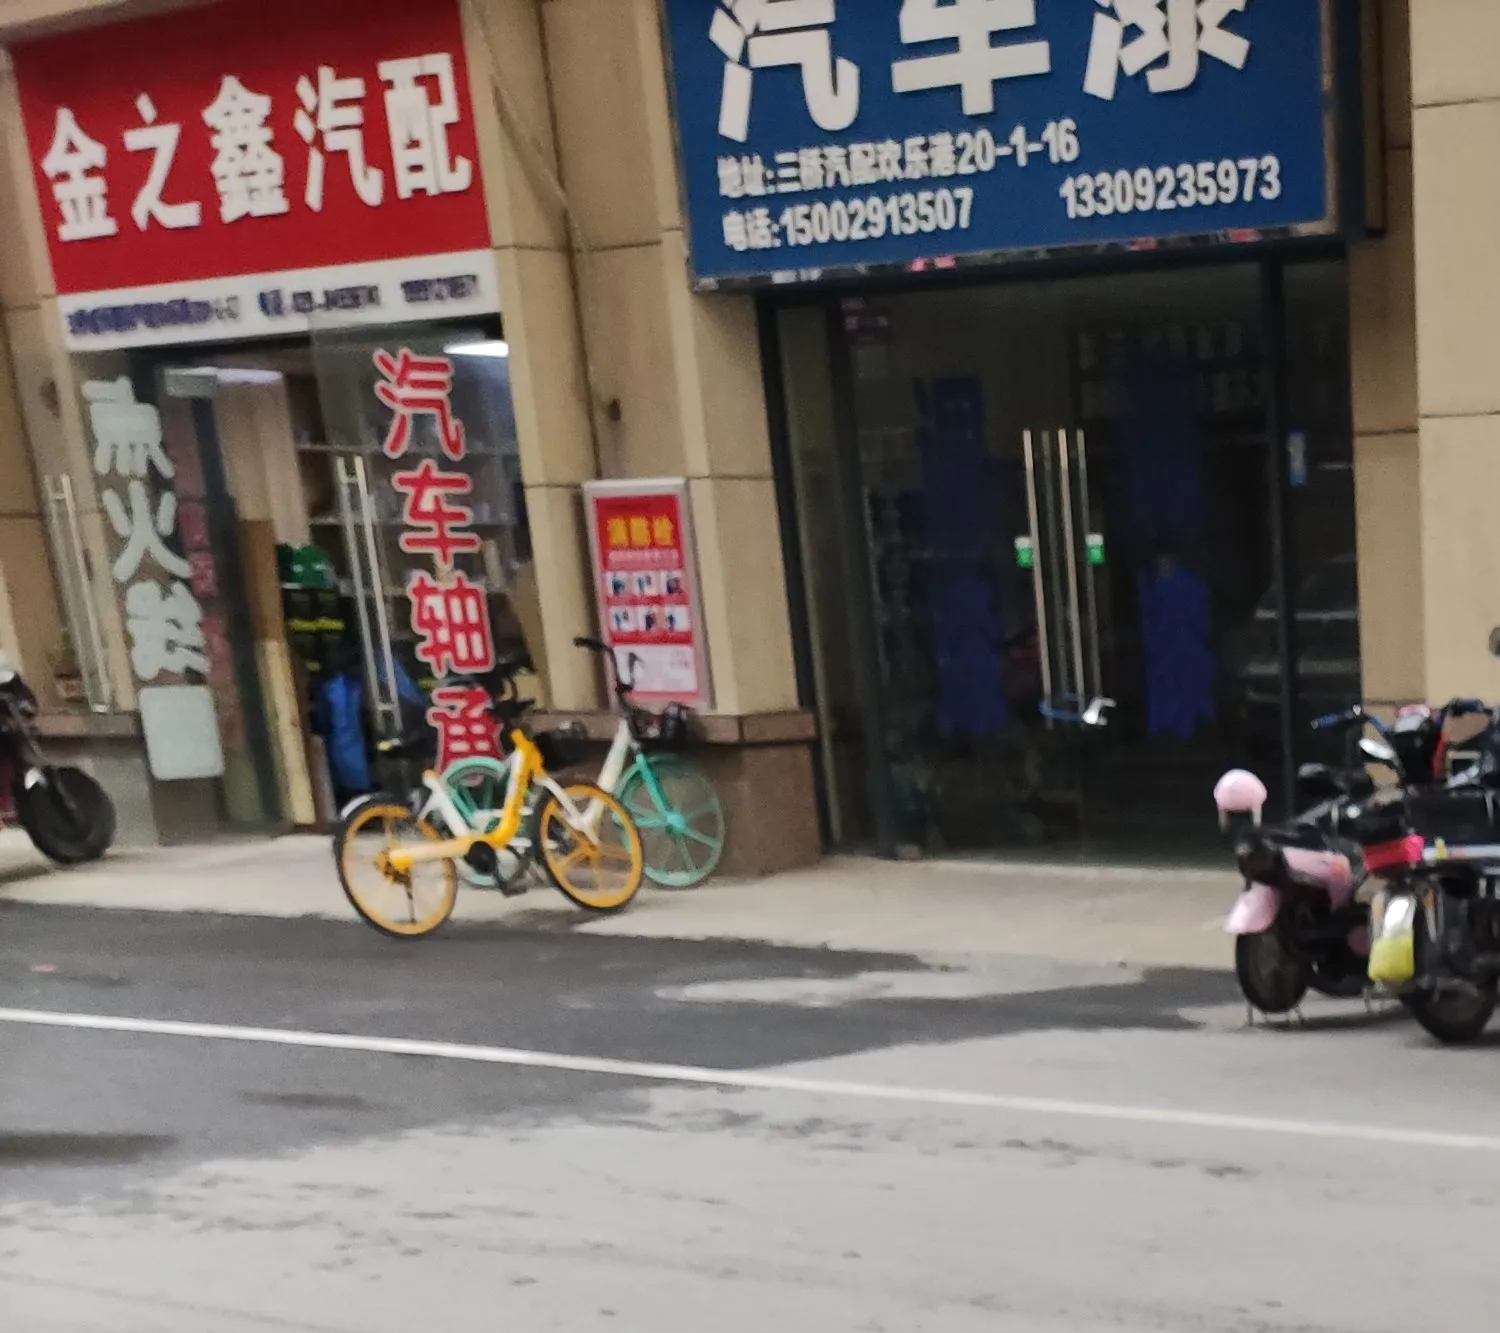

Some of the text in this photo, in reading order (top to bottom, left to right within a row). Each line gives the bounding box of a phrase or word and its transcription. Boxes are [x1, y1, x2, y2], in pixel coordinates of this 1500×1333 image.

[41, 52, 472, 242] 金之鑫汽配
[1059, 154, 1281, 219] 13309235973
